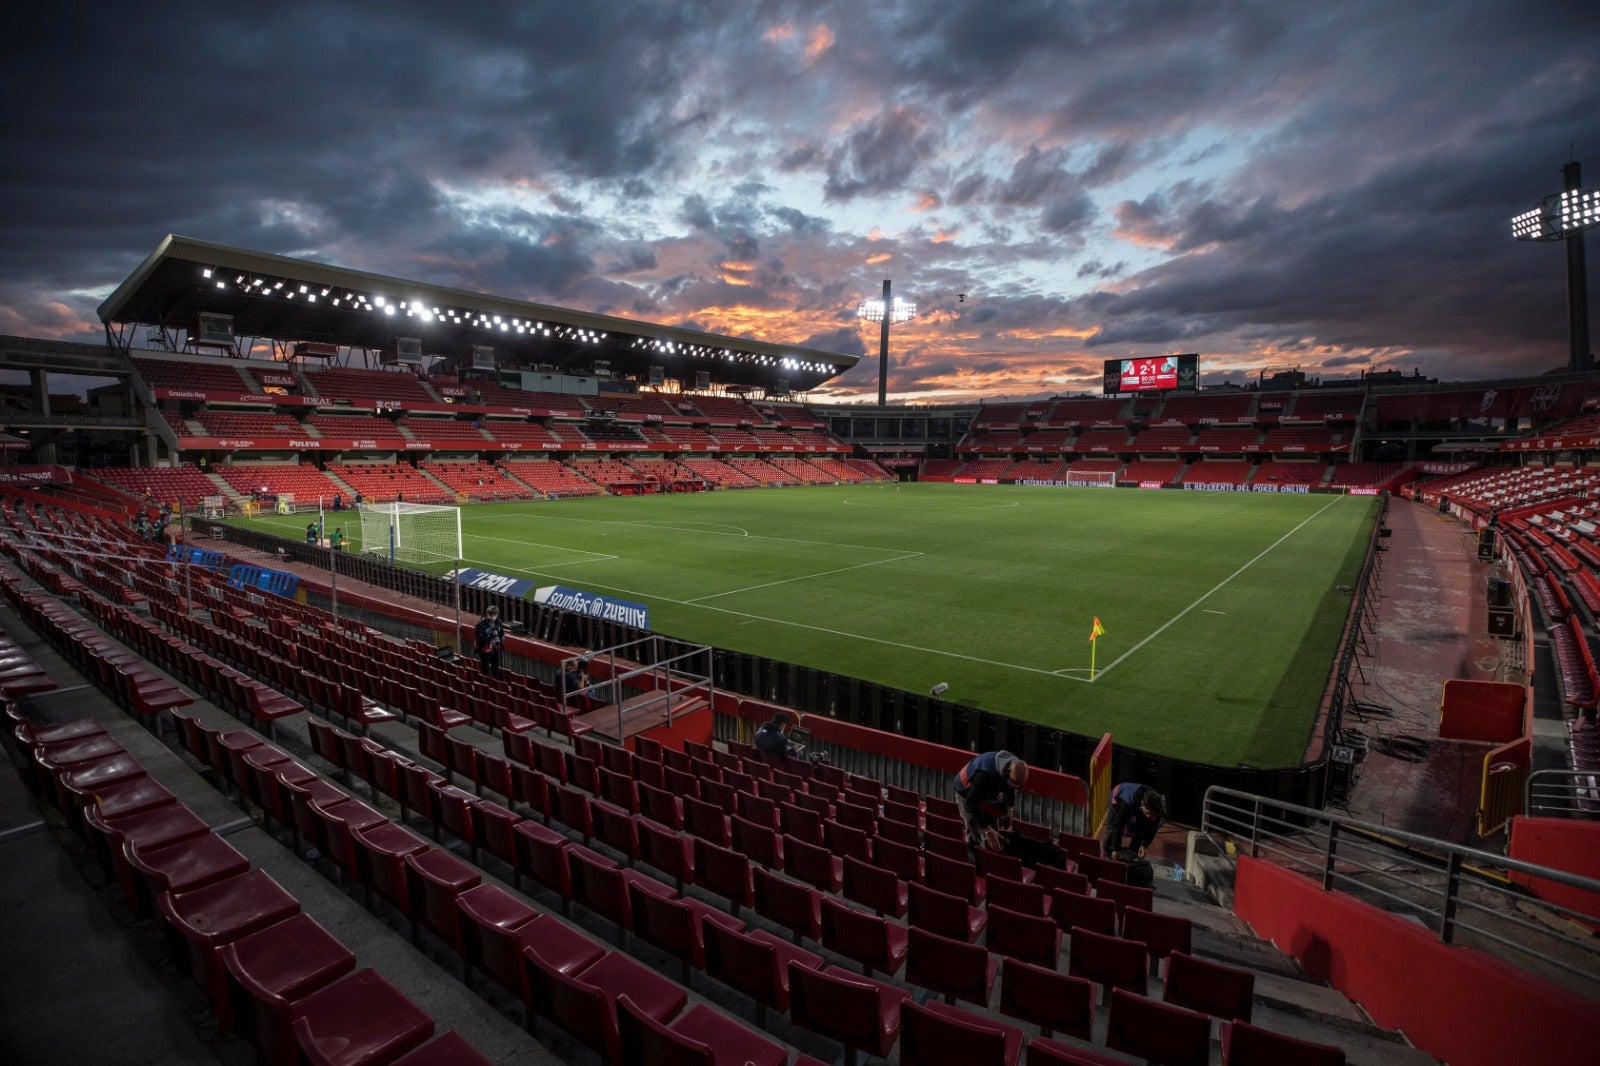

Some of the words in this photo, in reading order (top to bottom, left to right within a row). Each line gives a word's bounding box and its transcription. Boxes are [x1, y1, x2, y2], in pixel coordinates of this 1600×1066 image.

[263, 375, 294, 385] IDEAL
[194, 391, 206, 400] Hoy
[303, 397, 333, 406] IDEAL
[289, 440, 320, 448] PULEVA
[1194, 483, 1234, 492] REFERENTE
[1236, 484, 1250, 492] DEL
[1253, 484, 1278, 493] POKER
[1280, 485, 1310, 494] ONLINE
[1350, 488, 1377, 496] WINAMAX
[547, 591, 591, 614] Seguros
[602, 602, 647, 629] Allianz
